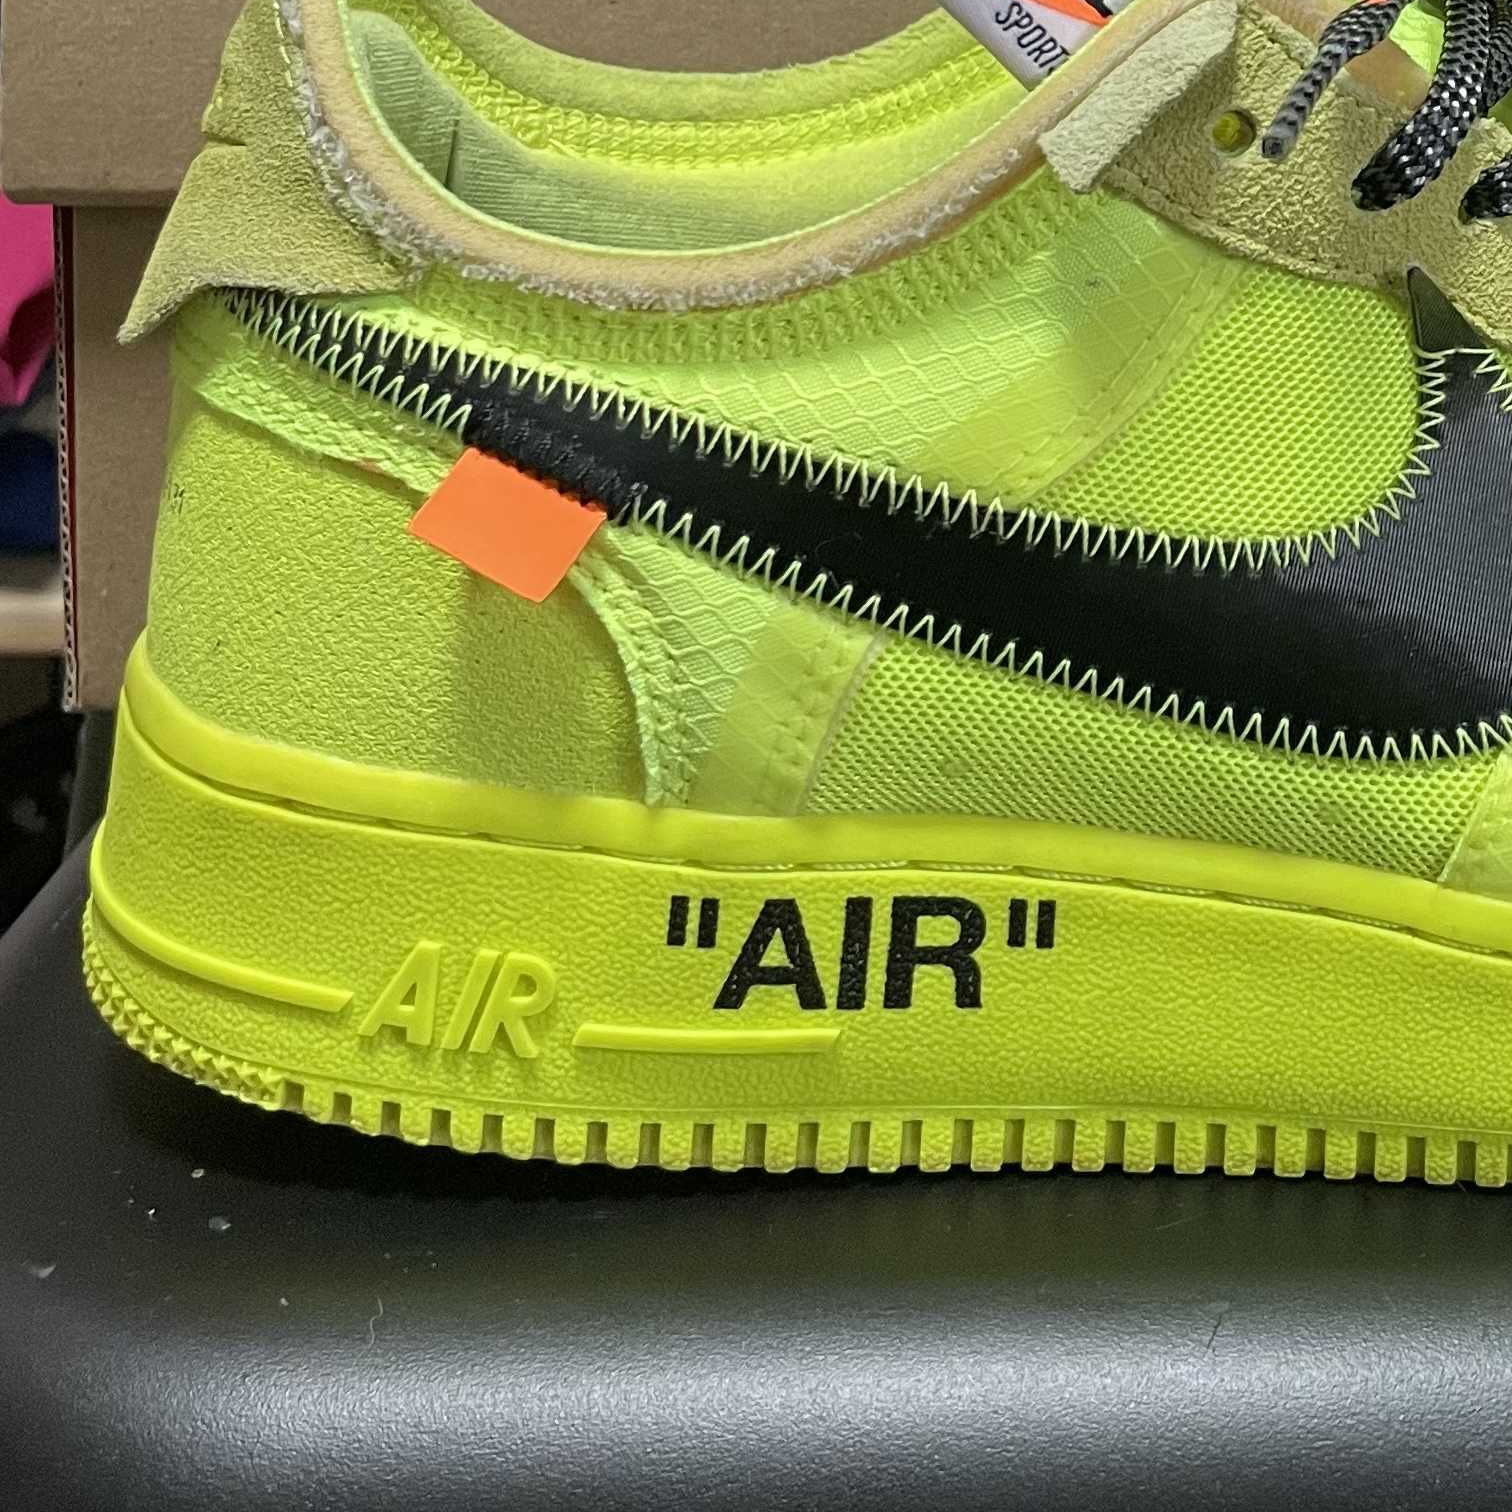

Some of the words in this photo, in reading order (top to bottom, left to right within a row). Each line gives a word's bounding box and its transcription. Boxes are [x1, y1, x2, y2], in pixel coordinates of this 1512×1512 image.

[995, 0, 1072, 77] SPORT
[357, 939, 555, 1060] AIR
[666, 894, 1057, 1011] "AIR"
